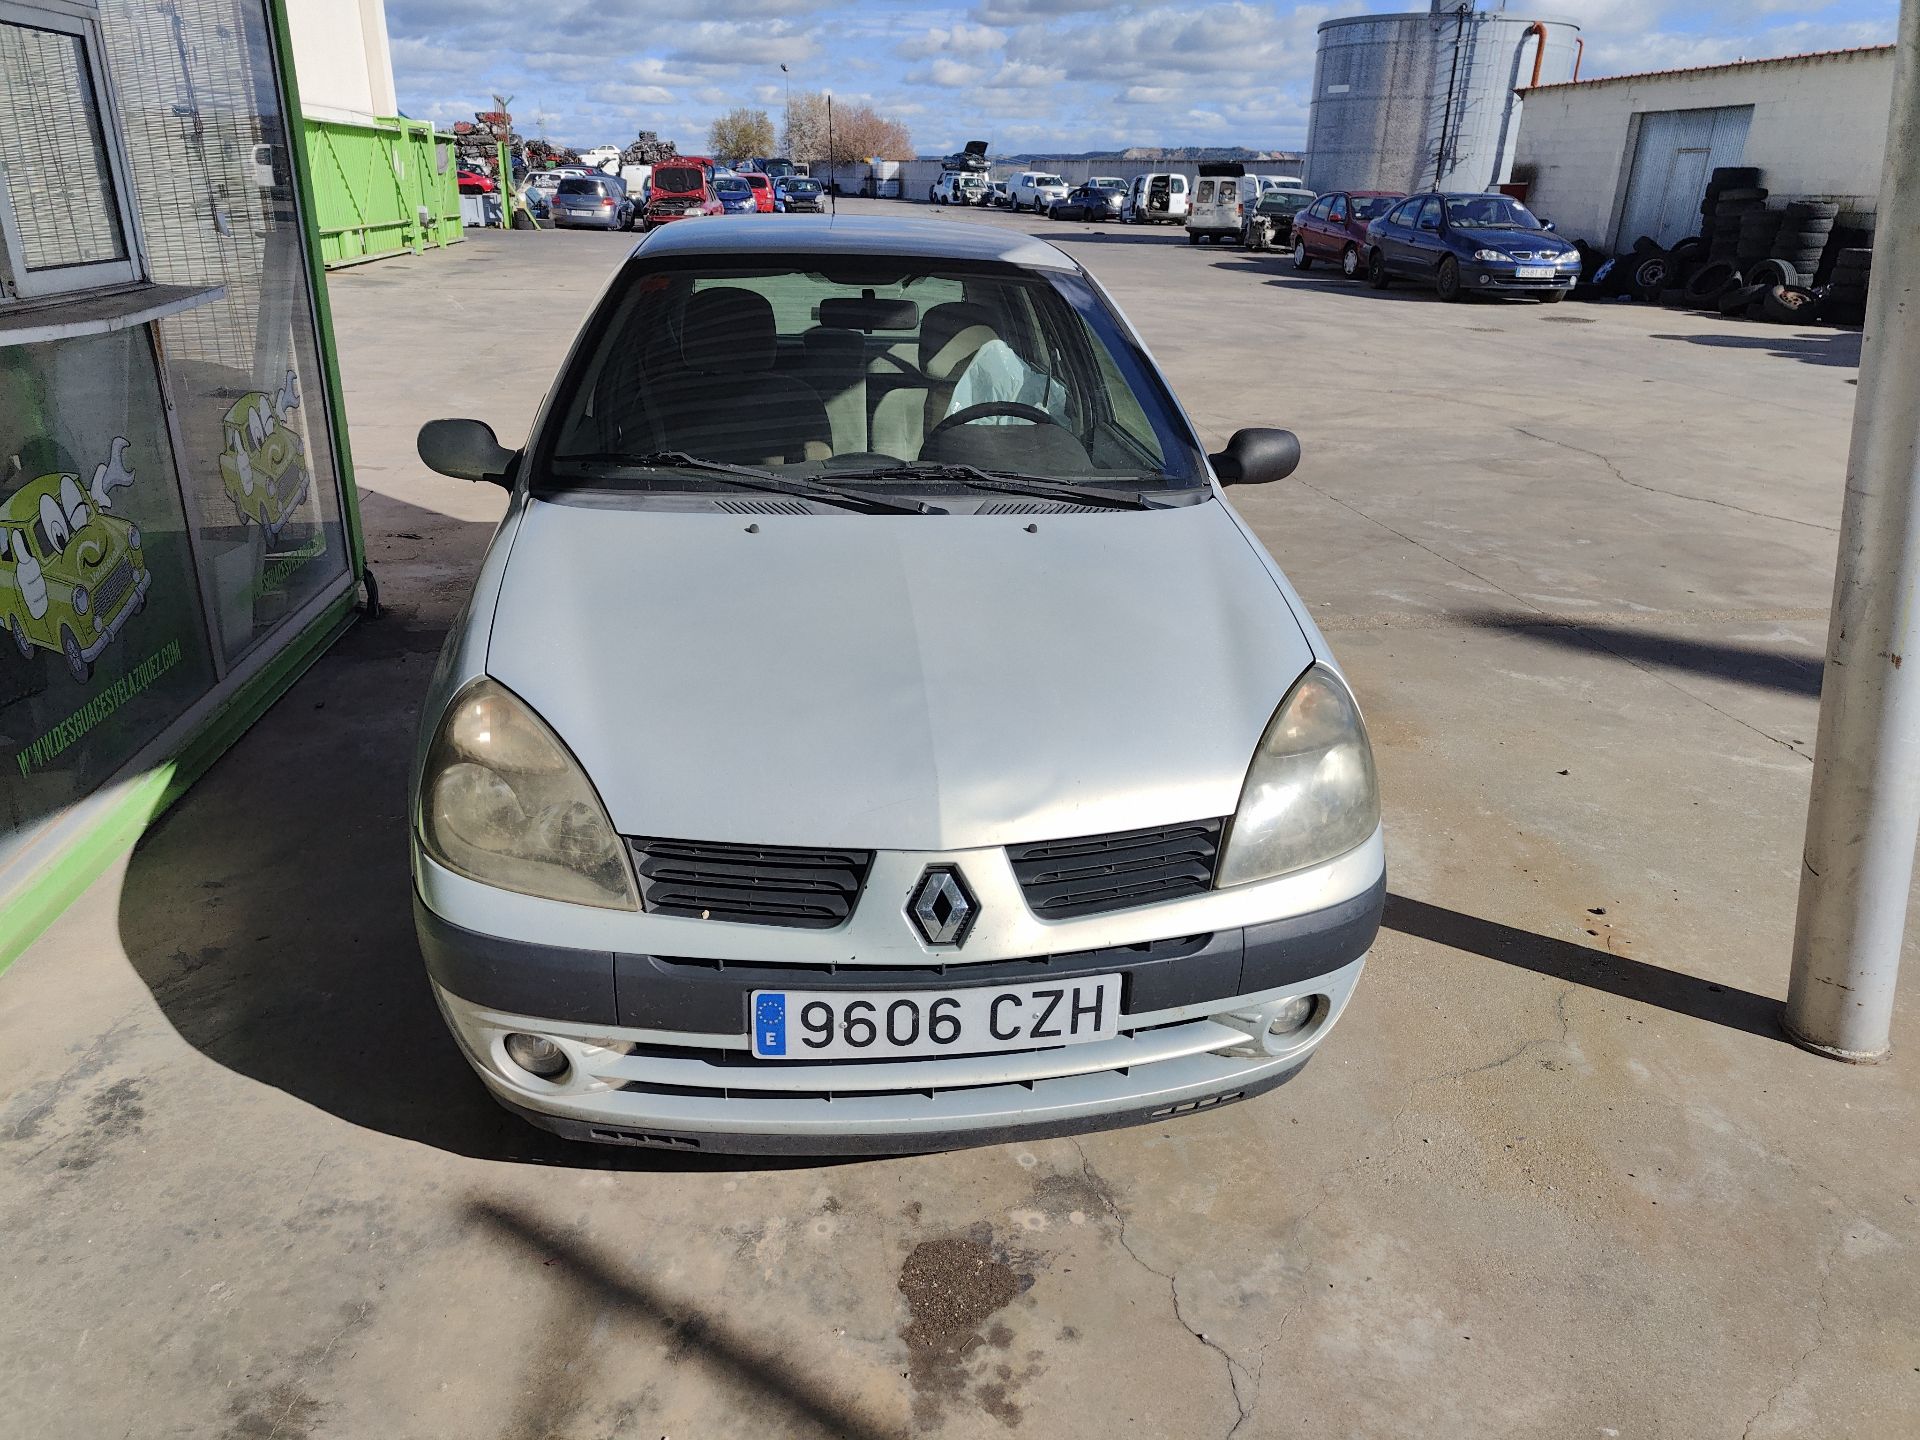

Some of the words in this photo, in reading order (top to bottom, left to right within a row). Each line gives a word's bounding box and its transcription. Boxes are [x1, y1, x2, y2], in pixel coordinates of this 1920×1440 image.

[16, 638, 183, 778] WWW.DESGUACESVELAZQUEZ.COM
[765, 1032, 777, 1046] E
[800, 997, 962, 1049] 9606
[989, 984, 1105, 1041] CZH
